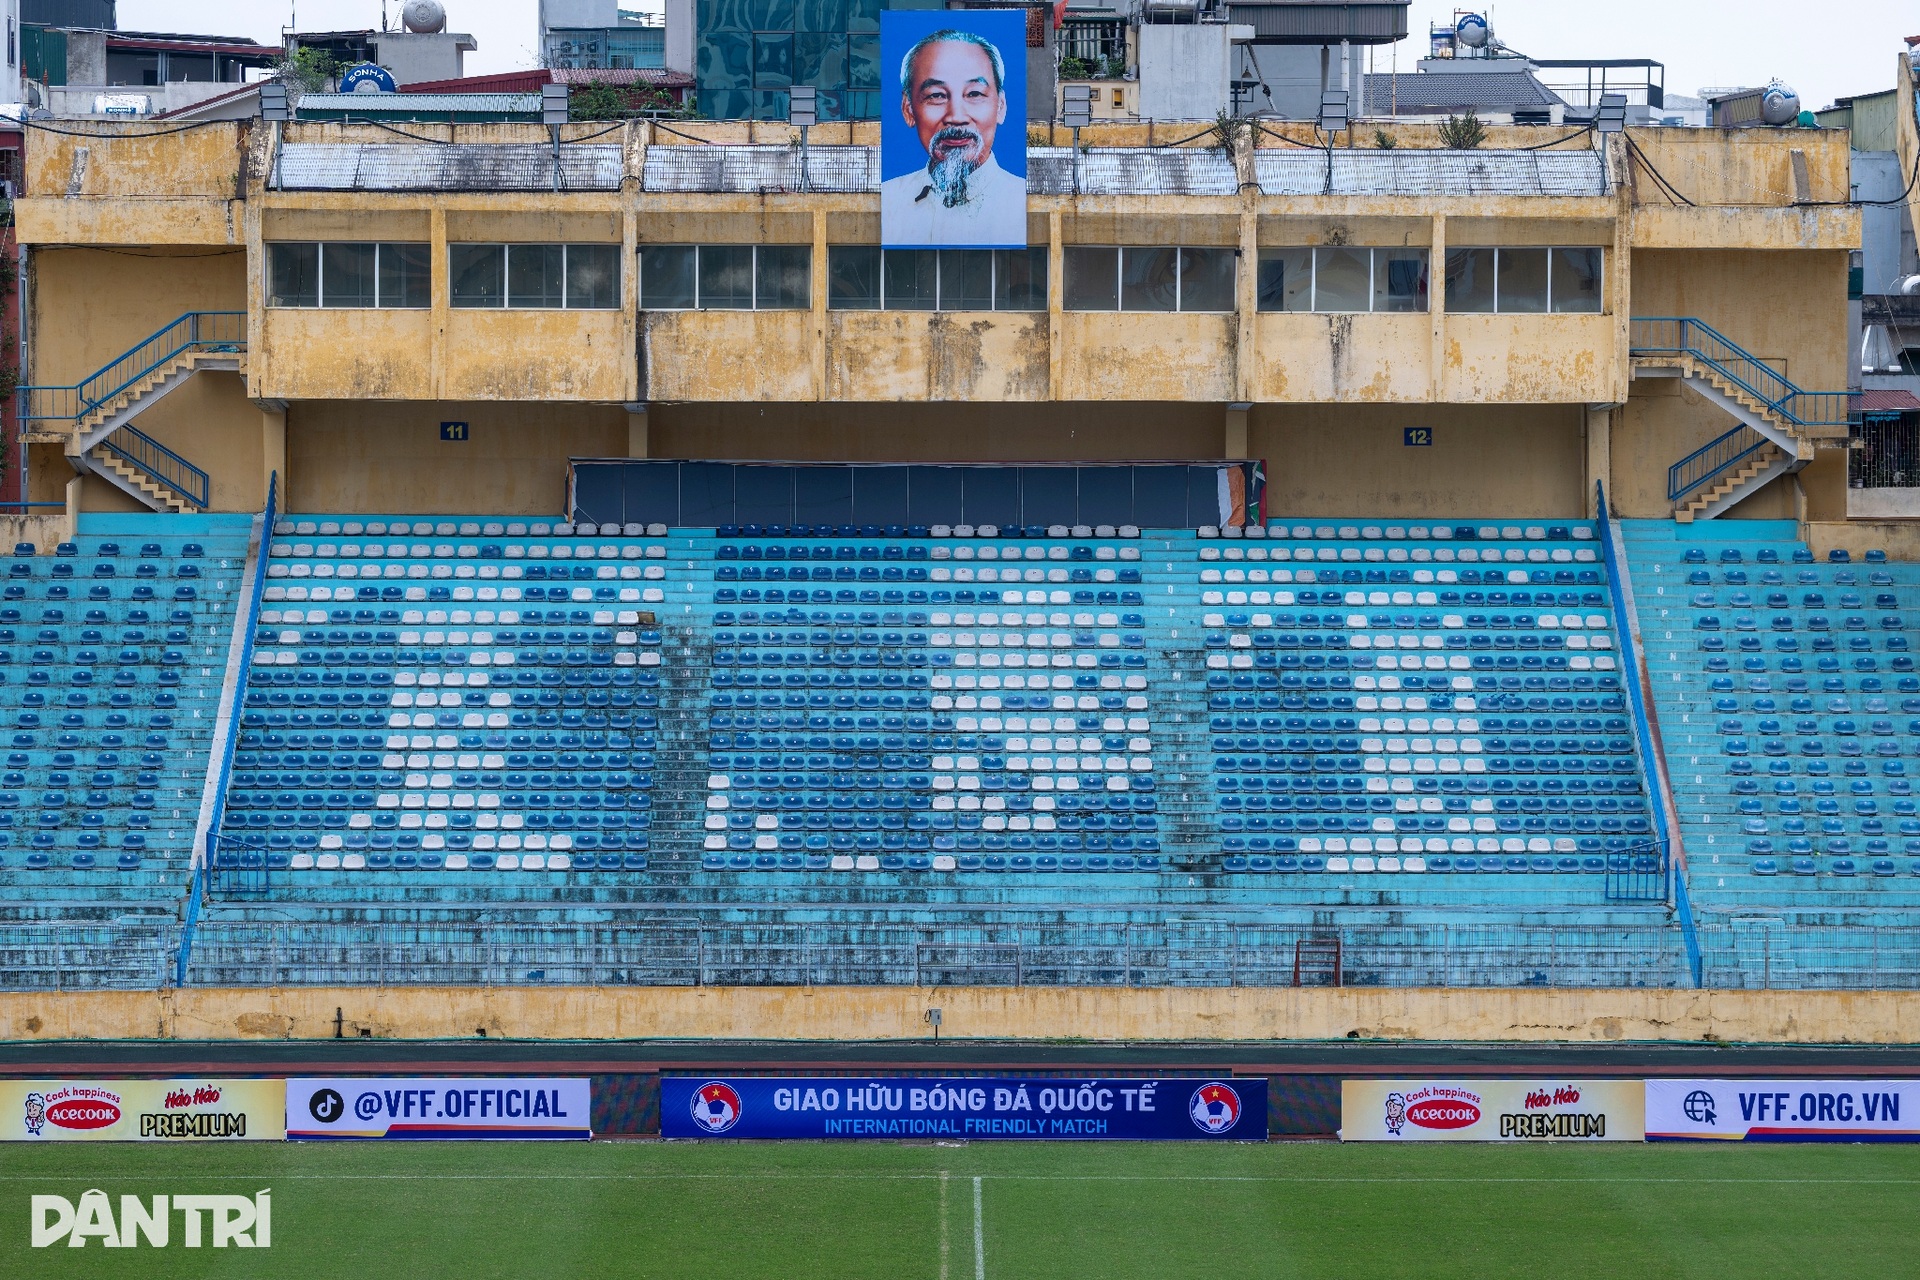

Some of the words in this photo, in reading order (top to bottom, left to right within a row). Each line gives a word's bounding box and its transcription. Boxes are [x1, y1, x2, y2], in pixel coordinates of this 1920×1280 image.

[348, 69, 384, 83] SONHA
[446, 425, 462, 438] 11
[1410, 430, 1428, 444] 12
[689, 540, 693, 548] T
[1165, 542, 1170, 550] T
[221, 560, 227, 568] S
[688, 561, 693, 569] S
[1167, 563, 1172, 571] S
[1654, 564, 1661, 572] S
[687, 583, 693, 591] Q
[1168, 585, 1173, 594] Q
[1657, 586, 1663, 595] Q
[1169, 609, 1175, 617] P
[1662, 609, 1668, 617] P
[684, 648, 690, 656] N
[1670, 653, 1677, 661] N
[202, 668, 210, 676] M
[1172, 672, 1181, 681] M
[1673, 673, 1681, 681] M
[1176, 693, 1181, 701] L
[1679, 693, 1684, 701] L
[194, 710, 200, 718] K
[1683, 714, 1689, 722] K
[1691, 756, 1697, 764] H
[1696, 775, 1702, 783] G
[1183, 793, 1189, 801] E
[1699, 795, 1705, 803] E
[1704, 815, 1710, 823] D
[1713, 855, 1719, 863] B
[159, 875, 165, 883] A
[1188, 877, 1195, 885] A
[1718, 878, 1724, 886] A
[46, 1088, 70, 1103] Cook
[72, 1087, 121, 1104] happiness
[774, 1088, 840, 1111] GIAO
[847, 1082, 902, 1111] HỮU
[910, 1084, 986, 1111] BÓNG
[994, 1084, 1032, 1111] ĐÁ
[1040, 1082, 1114, 1114] QUỐC
[1120, 1082, 1158, 1112] TẾ
[1406, 1088, 1430, 1103] Cook
[1433, 1086, 1481, 1104] happiness
[354, 1089, 567, 1121] @VFF.OFFICIAL
[1739, 1092, 1900, 1122] VFF.ORG.VN
[140, 1114, 246, 1138] PREMIUM
[826, 1119, 960, 1134] INTERNATIONAL
[965, 1119, 1047, 1134] FRIENDLY
[1052, 1120, 1107, 1134] MATCH
[1500, 1114, 1606, 1138] PREMIUM
